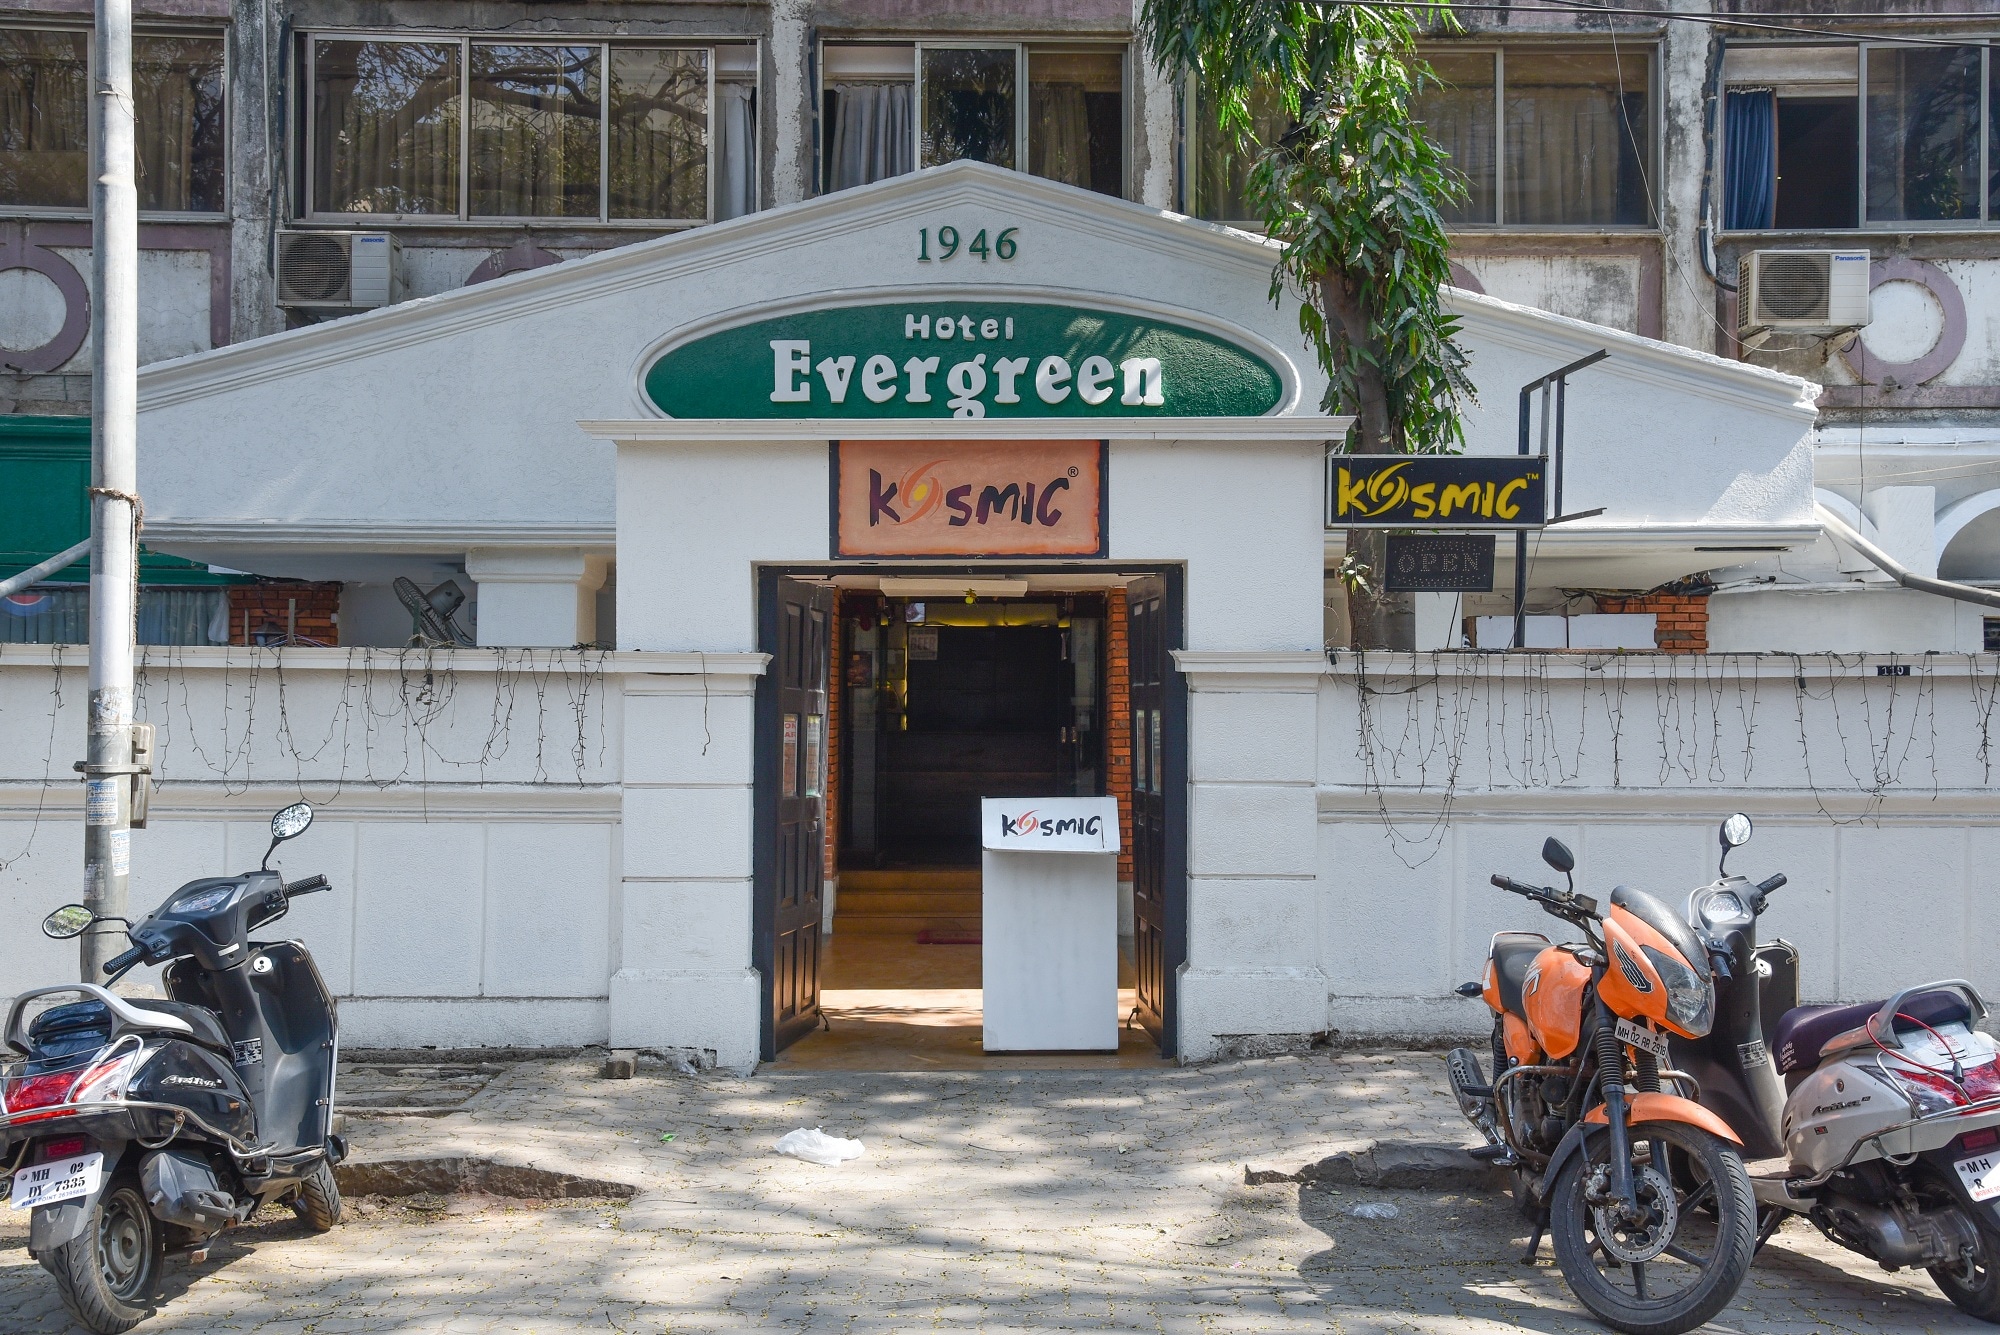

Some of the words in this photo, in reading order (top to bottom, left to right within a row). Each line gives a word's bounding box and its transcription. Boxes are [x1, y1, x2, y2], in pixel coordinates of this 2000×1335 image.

[917, 225, 1020, 263] 1946
[905, 313, 1014, 341] Hotel
[769, 339, 1166, 419] Evergreen
[1398, 552, 1482, 573] OPEN
[1616, 1025, 1630, 1040] MH
[1630, 1031, 1641, 1044] 02
[30, 1167, 51, 1182] MH
[69, 1161, 84, 1175] 02
[1965, 1158, 1992, 1174] MH
[28, 1183, 45, 1198] DY
[54, 1175, 86, 1193] 7335
[21, 1198, 36, 1207] BIKE
[37, 1194, 57, 1203] POINT
